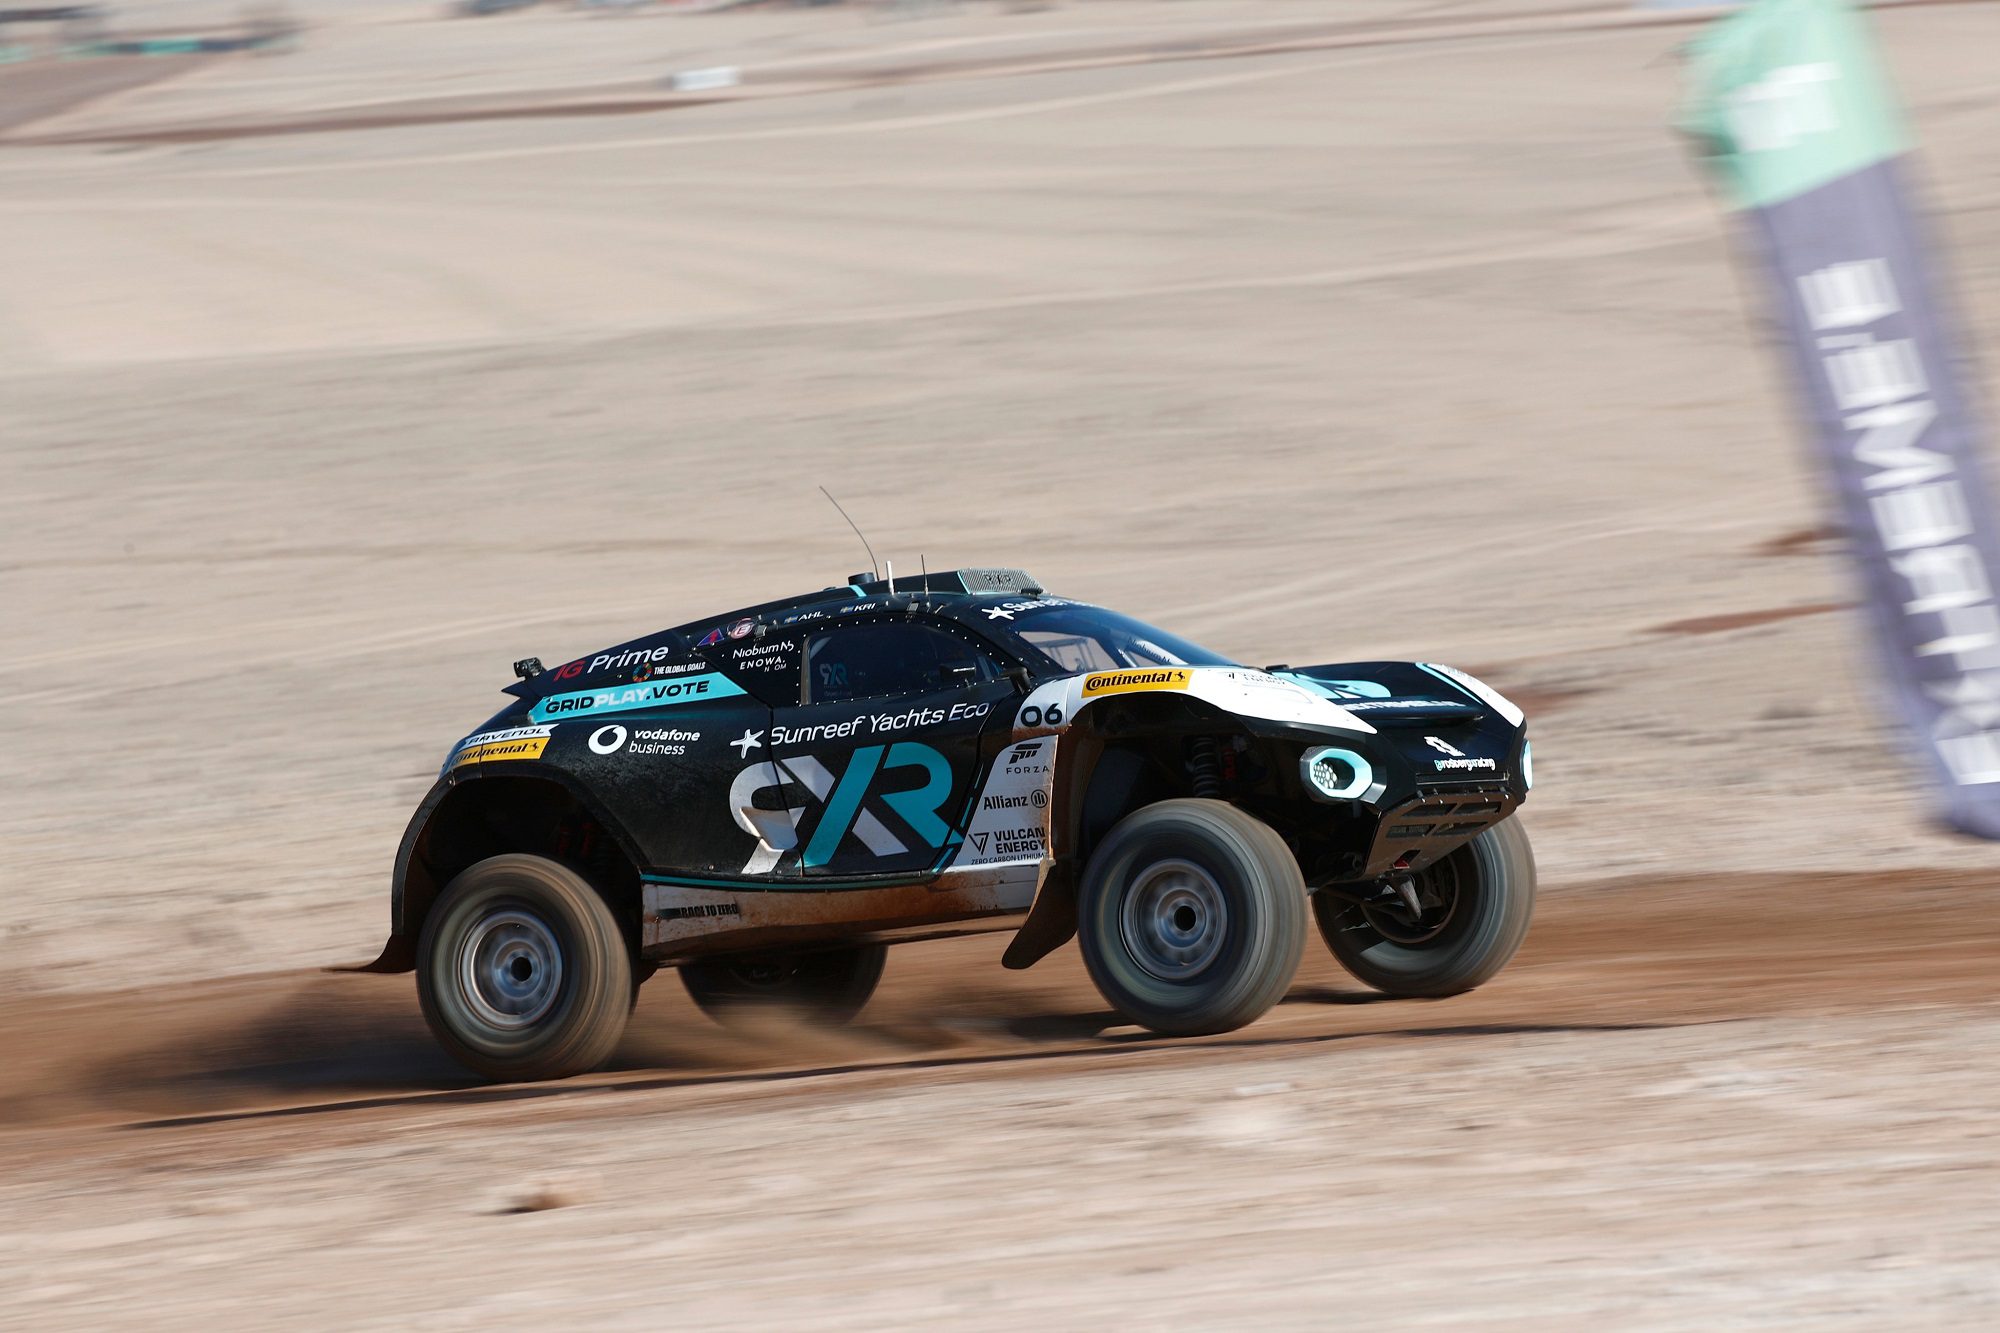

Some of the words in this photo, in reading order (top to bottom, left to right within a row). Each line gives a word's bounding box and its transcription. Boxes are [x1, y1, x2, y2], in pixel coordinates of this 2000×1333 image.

[854, 598, 876, 612] KRI
[553, 660, 586, 682] IG
[587, 646, 669, 674] Prime
[654, 666, 665, 675] THE
[665, 664, 687, 674] GLOBAL
[687, 661, 706, 672] GOALS
[1086, 672, 1172, 690] Continental
[1020, 703, 1063, 727] 06
[770, 716, 865, 746] Sunreef
[870, 707, 945, 733] Yachts
[948, 702, 990, 721] Eco
[634, 728, 700, 741] vodafone
[629, 741, 685, 755] business
[1006, 765, 1050, 774] FORZA
[984, 796, 1028, 810] Allianz
[994, 827, 1046, 841] VULCAN
[996, 839, 1046, 854] ENERGY
[989, 855, 1017, 864] CARBON
[1016, 852, 1045, 860] LITHIUM
[705, 904, 717, 916] TO
[717, 903, 738, 916] ZERO
